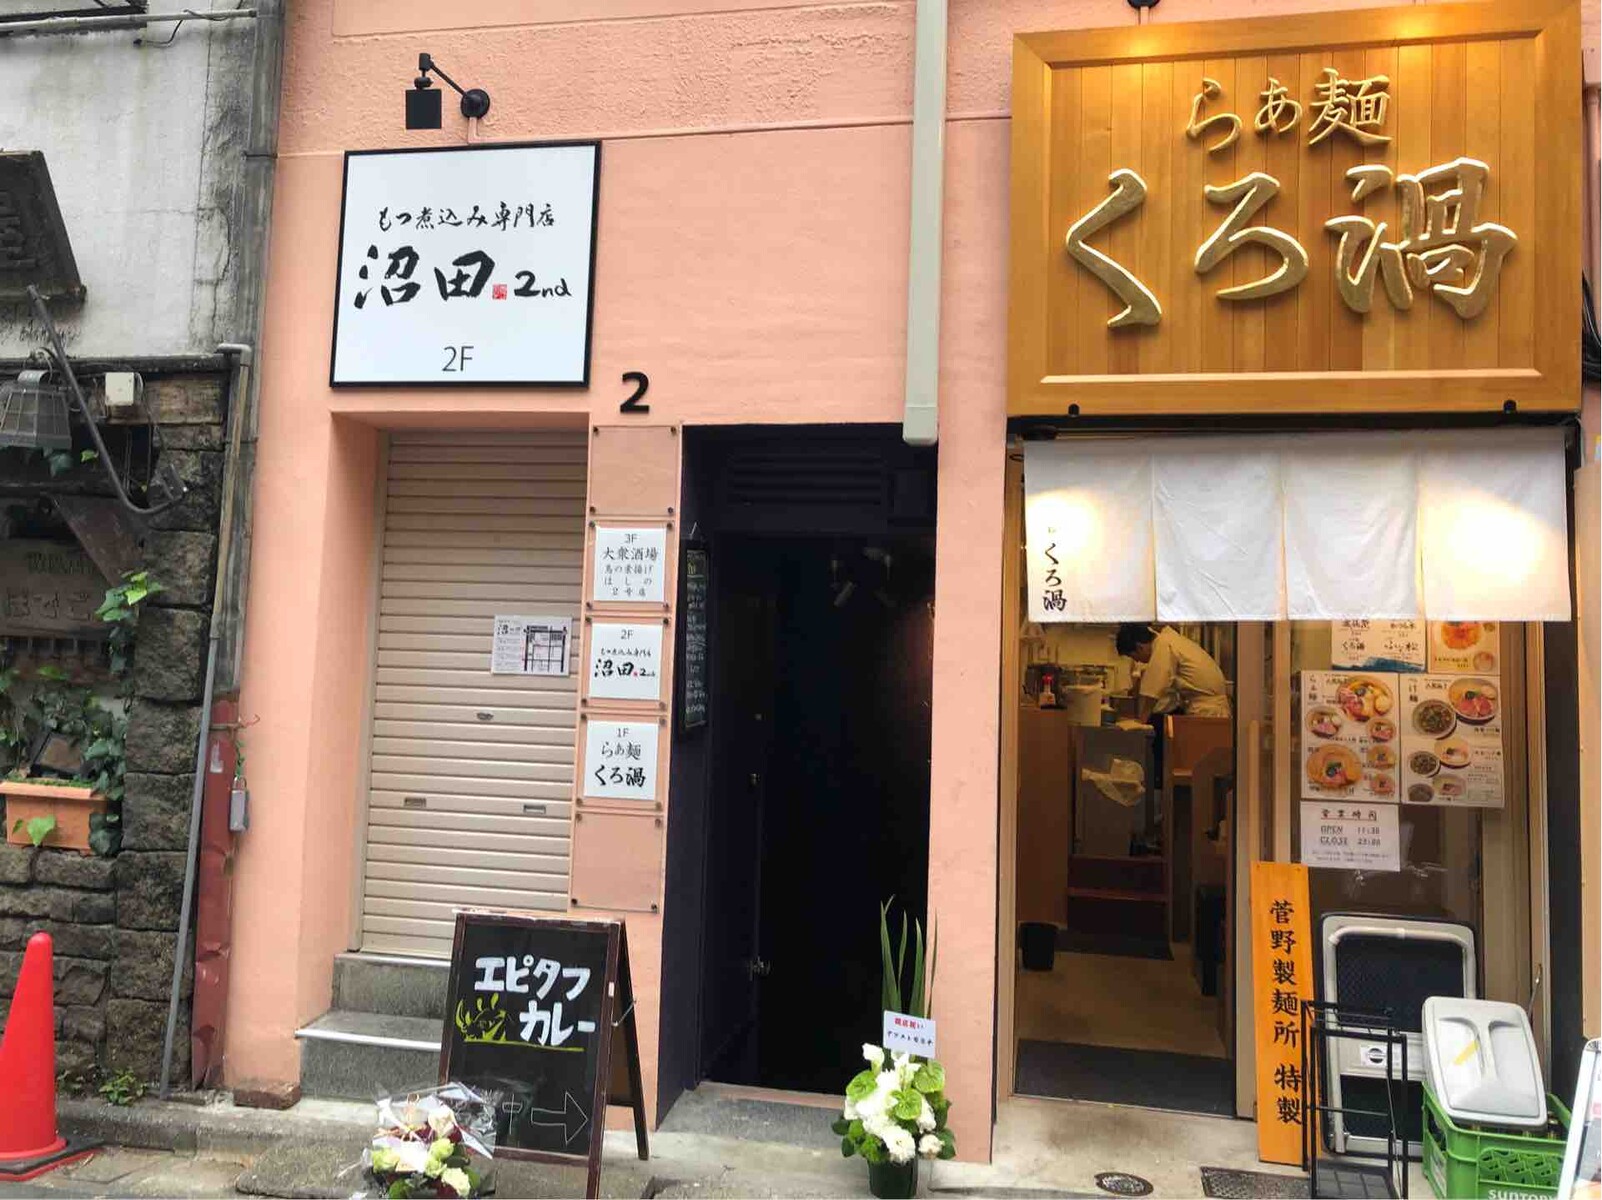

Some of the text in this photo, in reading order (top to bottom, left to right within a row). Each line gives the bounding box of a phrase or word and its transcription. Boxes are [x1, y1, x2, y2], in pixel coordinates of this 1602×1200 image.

[378, 201, 555, 231] もつ煮込み専門店
[1066, 156, 1518, 328] くろ渦
[354, 245, 573, 309] 沼田 2nd
[442, 346, 474, 372] 2F
[620, 371, 649, 414] 2
[624, 533, 638, 544] 3F
[603, 546, 659, 561] 大衆酒場
[620, 629, 634, 640] 2F
[594, 658, 634, 677] 沼田
[616, 728, 630, 738] 1F
[594, 764, 647, 787] くろ渦
[474, 954, 591, 1001] エピタフ
[1270, 900, 1300, 1048] 菅野製麺所
[519, 1000, 597, 1047] カレー
